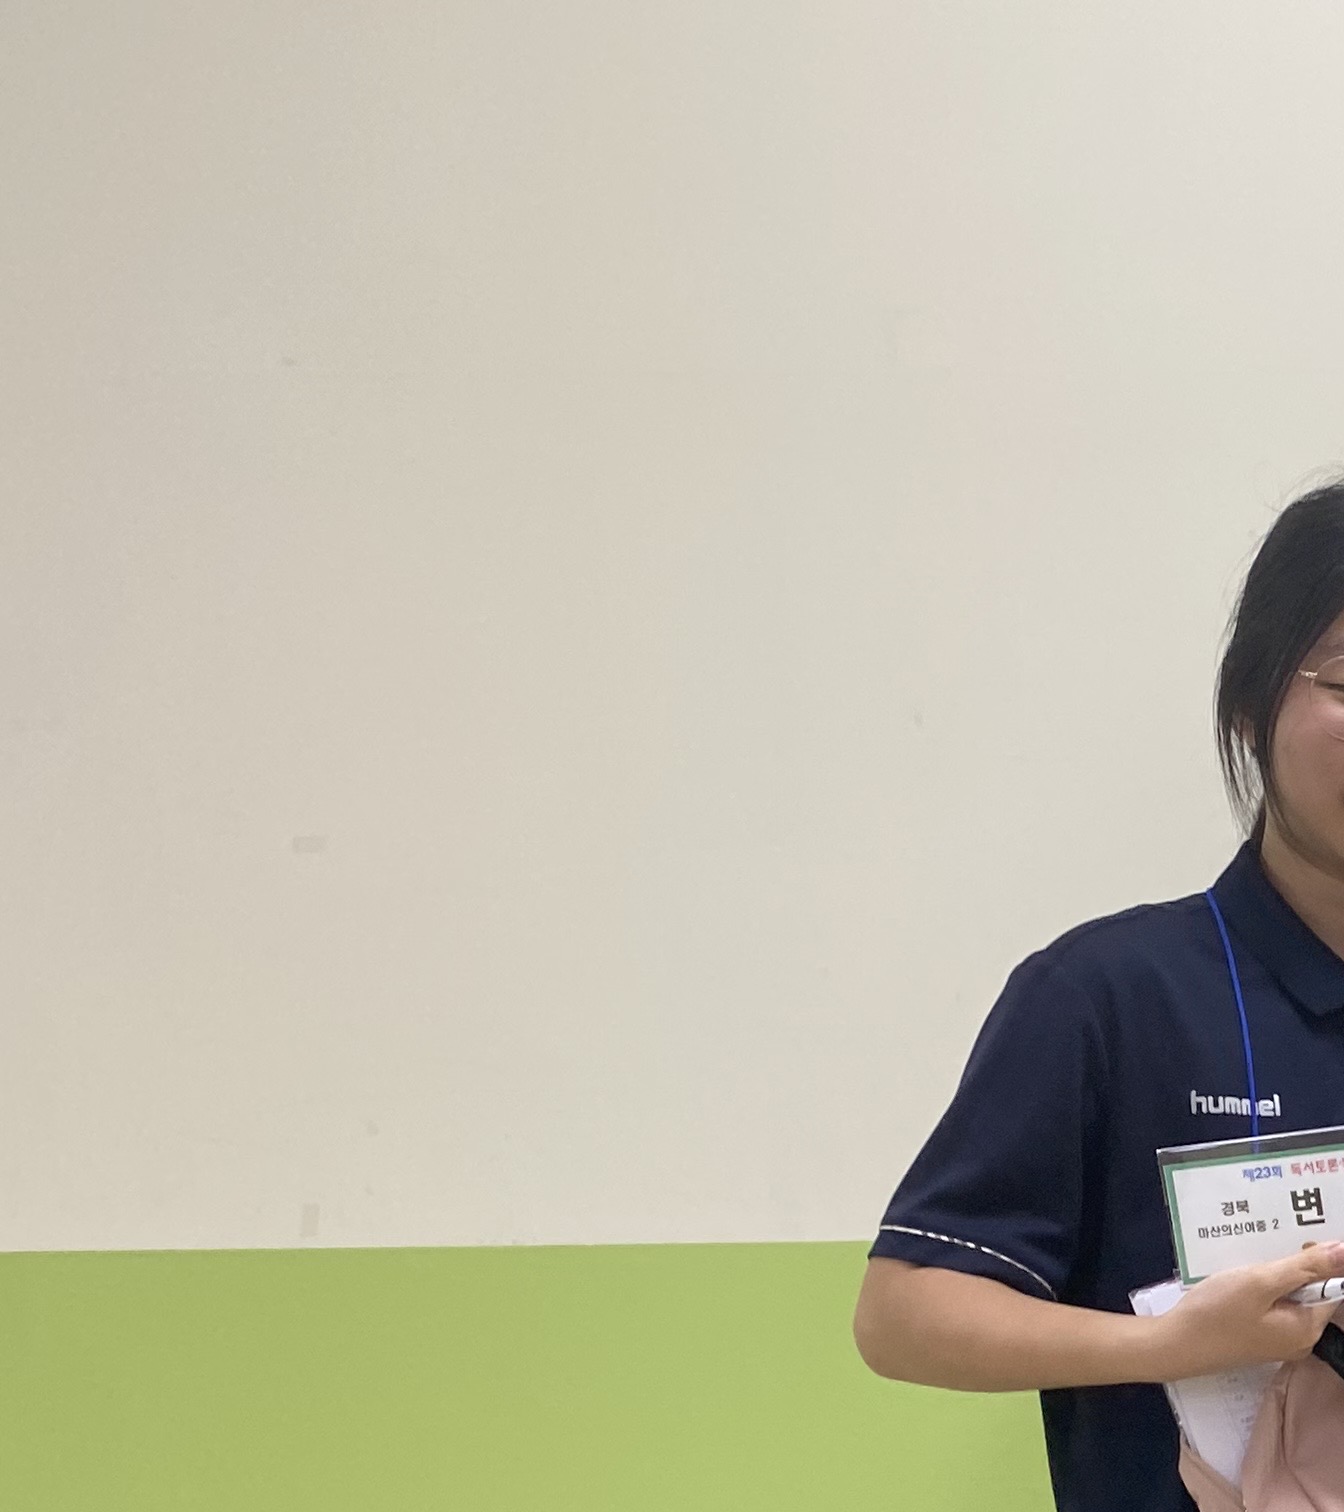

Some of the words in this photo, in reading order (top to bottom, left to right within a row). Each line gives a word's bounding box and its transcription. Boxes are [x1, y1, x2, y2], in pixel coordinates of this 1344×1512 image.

[1190, 1089, 1282, 1118] hummel
[1242, 1164, 1283, 1182] 제23회
[1220, 1200, 1251, 1217] 경북
[1272, 1218, 1281, 1231] 2
